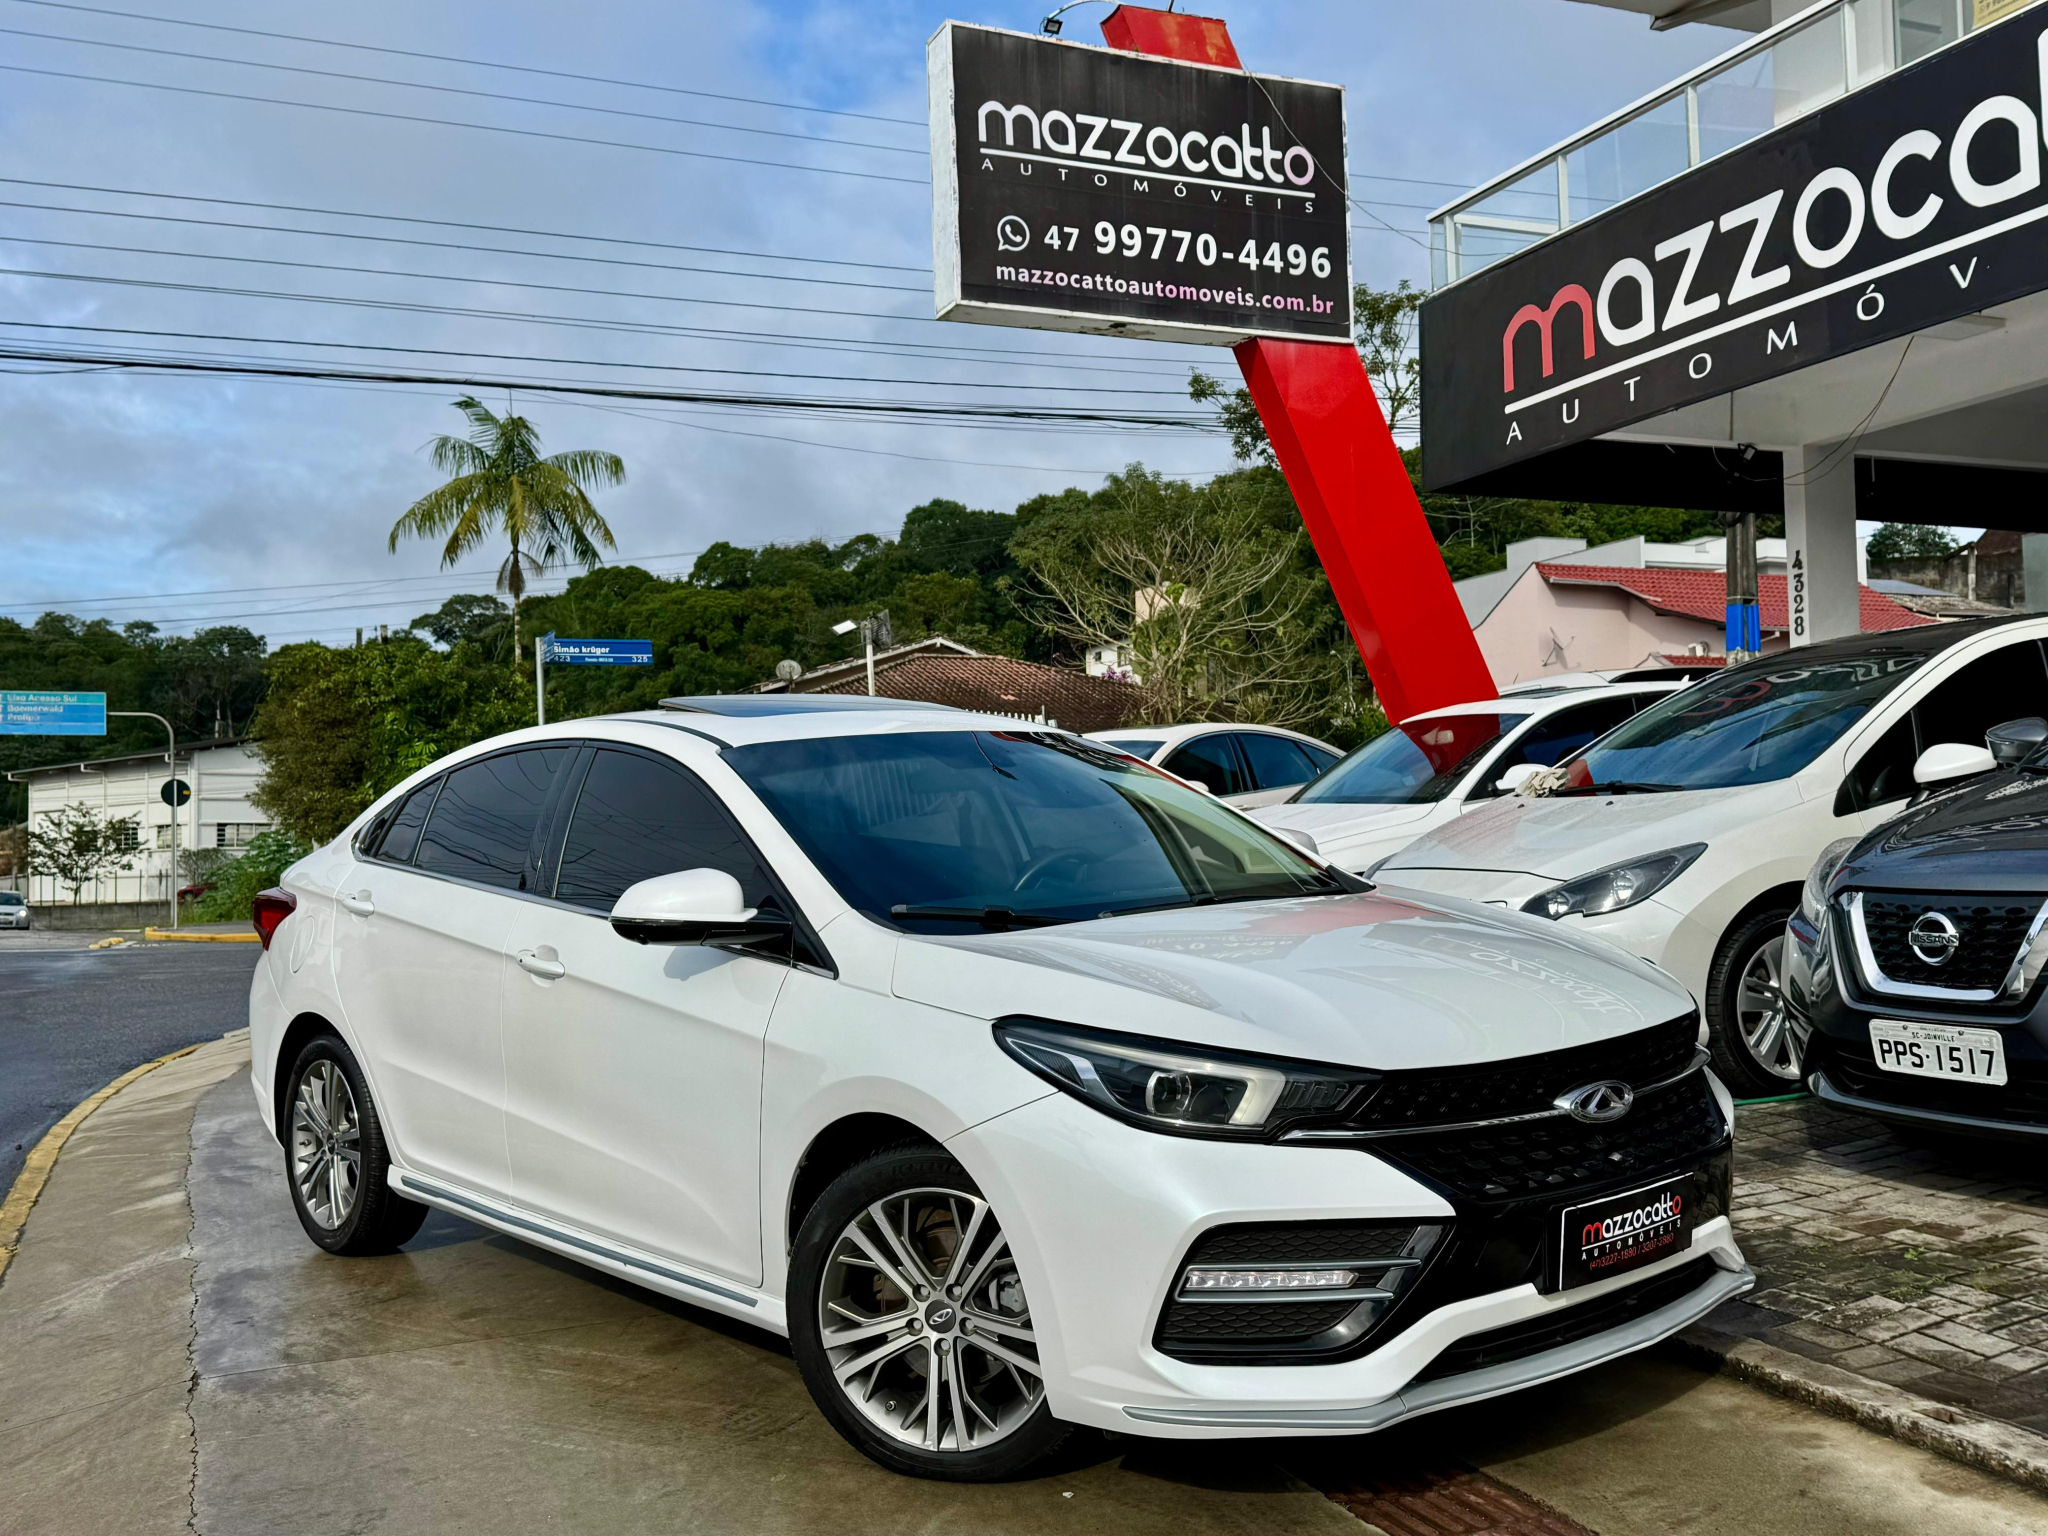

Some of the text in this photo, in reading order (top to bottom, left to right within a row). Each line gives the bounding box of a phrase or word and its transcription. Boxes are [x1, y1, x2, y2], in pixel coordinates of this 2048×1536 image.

[977, 100, 1315, 187] mazzocatto
[981, 157, 1314, 213] AUTOMÓVEIS
[1043, 220, 1332, 279] 47 99770-4496
[996, 263, 1334, 314] mazzocattoautomoveis.com.br
[1505, 256, 1979, 446] AUTOMÓV
[1792, 549, 1804, 636] 4328
[63, 694, 77, 702] Sul
[1911, 933, 1950, 944] NISSAN
[1581, 1219, 1681, 1261] AUTOMÓVEIS
[1582, 1192, 1682, 1245] mazzocatto
